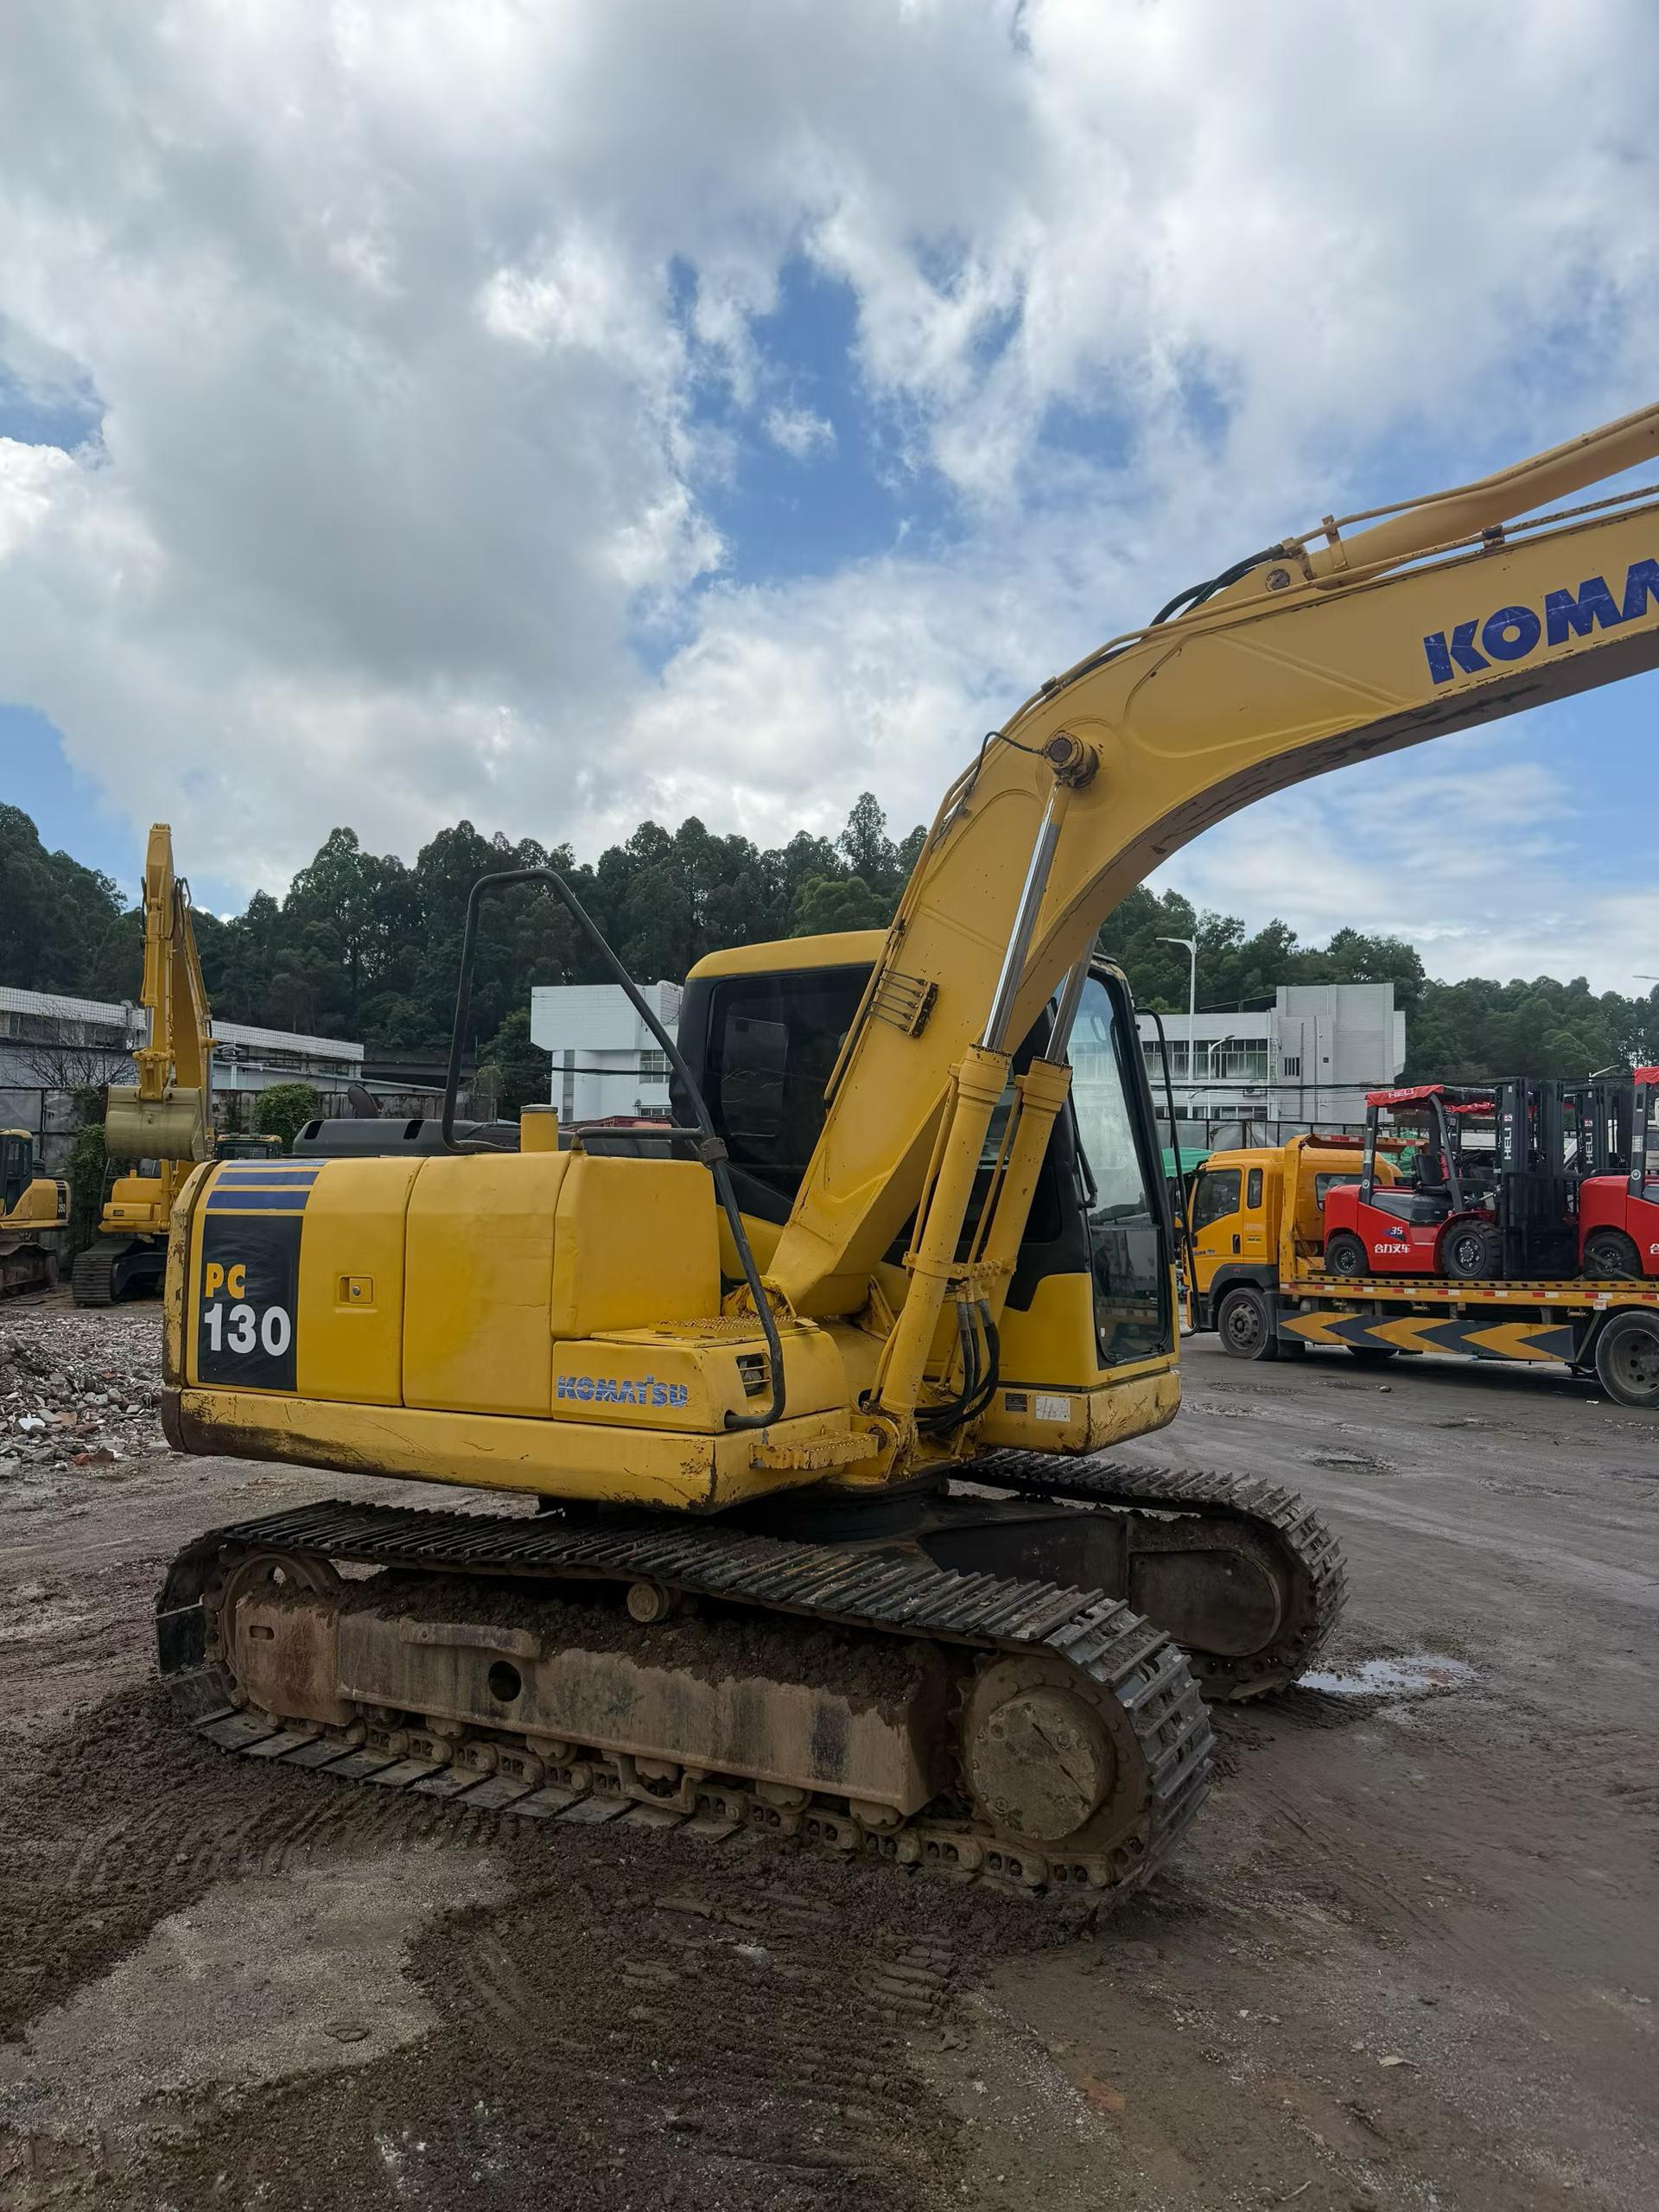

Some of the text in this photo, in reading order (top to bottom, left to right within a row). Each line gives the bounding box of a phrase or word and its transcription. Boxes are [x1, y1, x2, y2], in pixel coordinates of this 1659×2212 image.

[1388, 1089, 1414, 1098] HELI
[1503, 1127, 1512, 1160] HELI
[1390, 1226, 1403, 1235] 35
[1374, 1243, 1410, 1254] 合力叉车
[206, 1262, 246, 1300] PC
[204, 1303, 291, 1357] 130
[557, 1375, 689, 1408] KOMATSU
